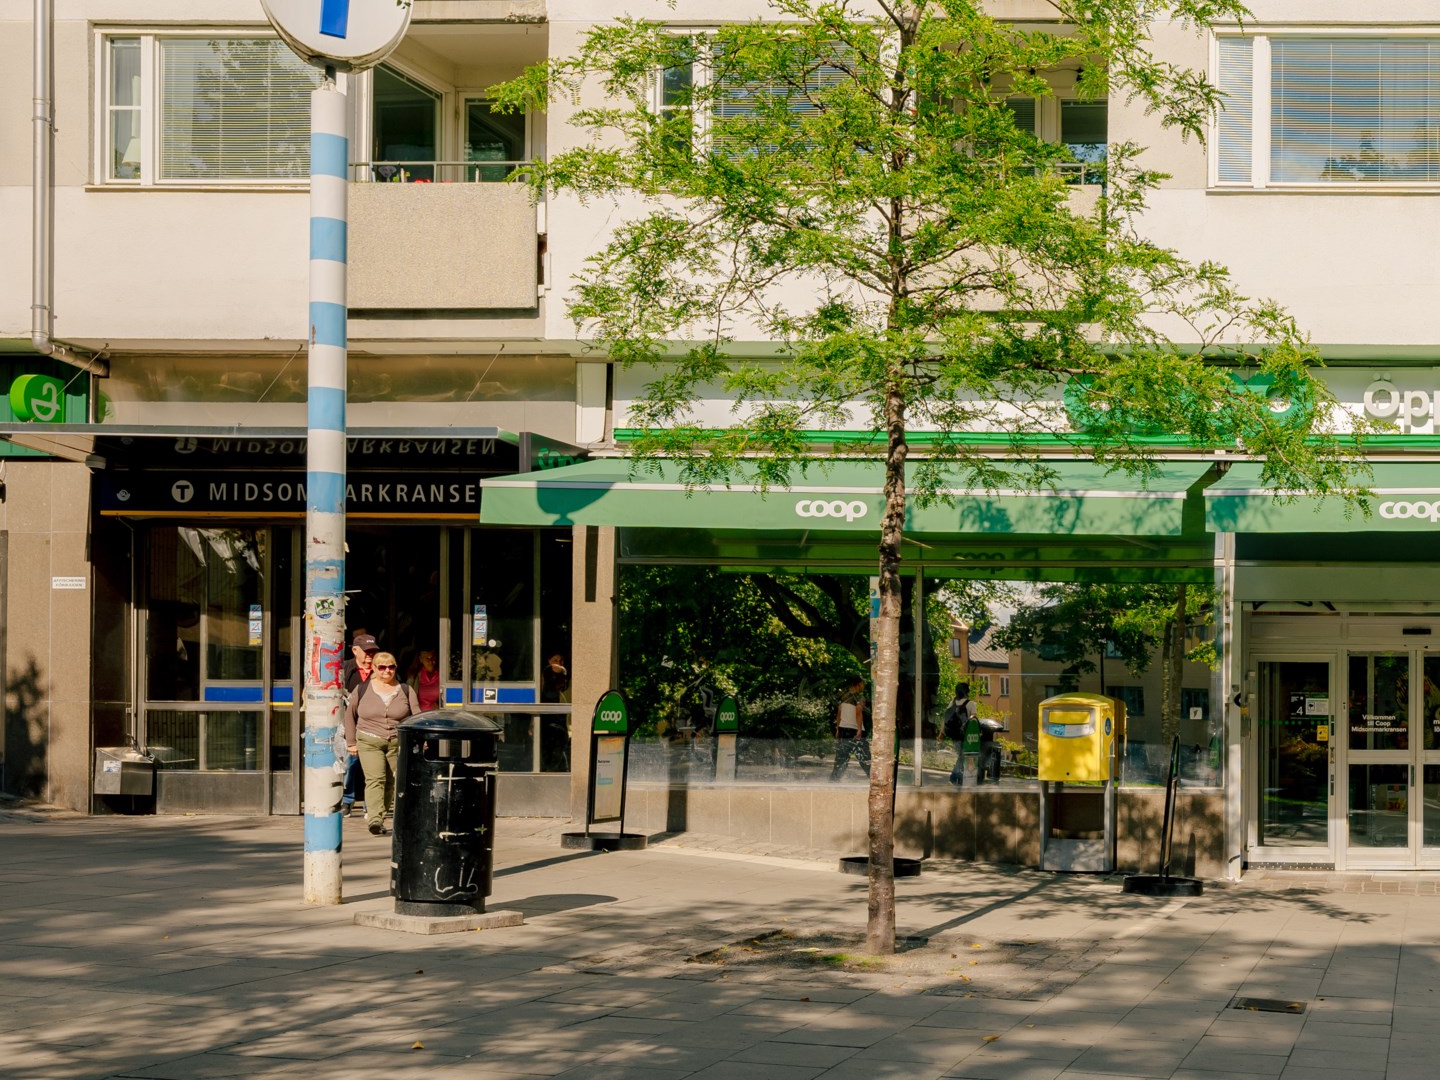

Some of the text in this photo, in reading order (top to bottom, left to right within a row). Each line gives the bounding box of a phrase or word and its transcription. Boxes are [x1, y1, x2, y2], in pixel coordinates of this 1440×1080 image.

[209, 482, 476, 503] MIDSOMARKRANSE
[795, 499, 868, 522] coop
[600, 710, 622, 724] coop
